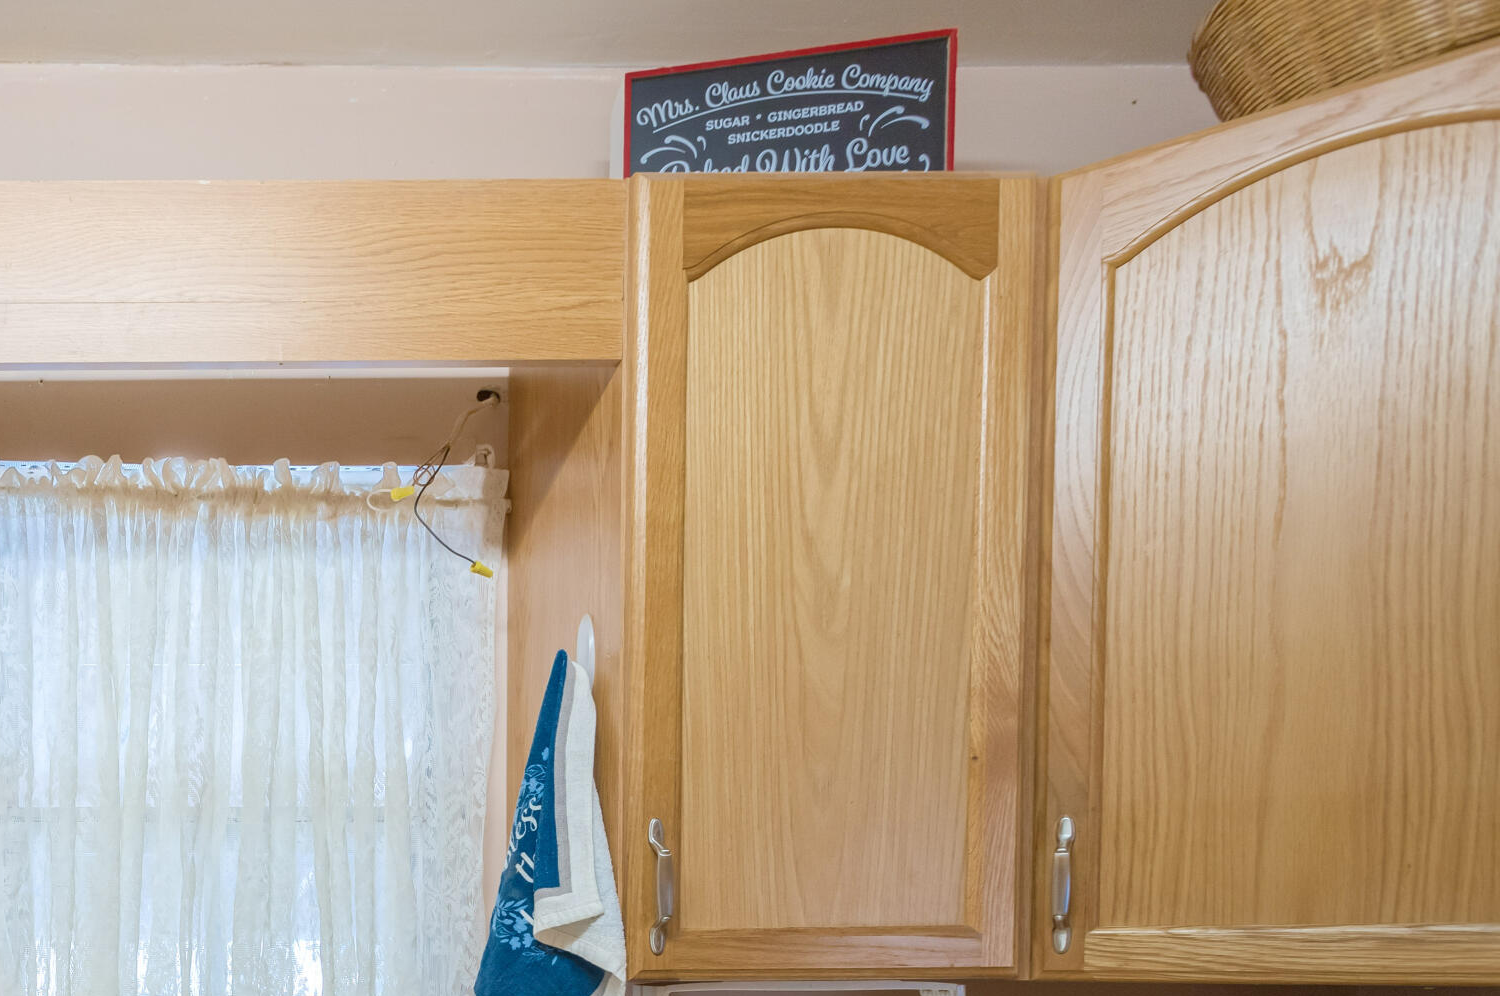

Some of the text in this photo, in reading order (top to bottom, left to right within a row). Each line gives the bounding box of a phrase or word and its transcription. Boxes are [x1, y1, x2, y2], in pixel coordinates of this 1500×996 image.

[636, 63, 935, 128] Mrs. Claus Cookie Company
[705, 100, 865, 131] SUGAR GINGERBREAD
[727, 120, 841, 145] SNICKERDOODLE
[844, 137, 911, 172] Love
